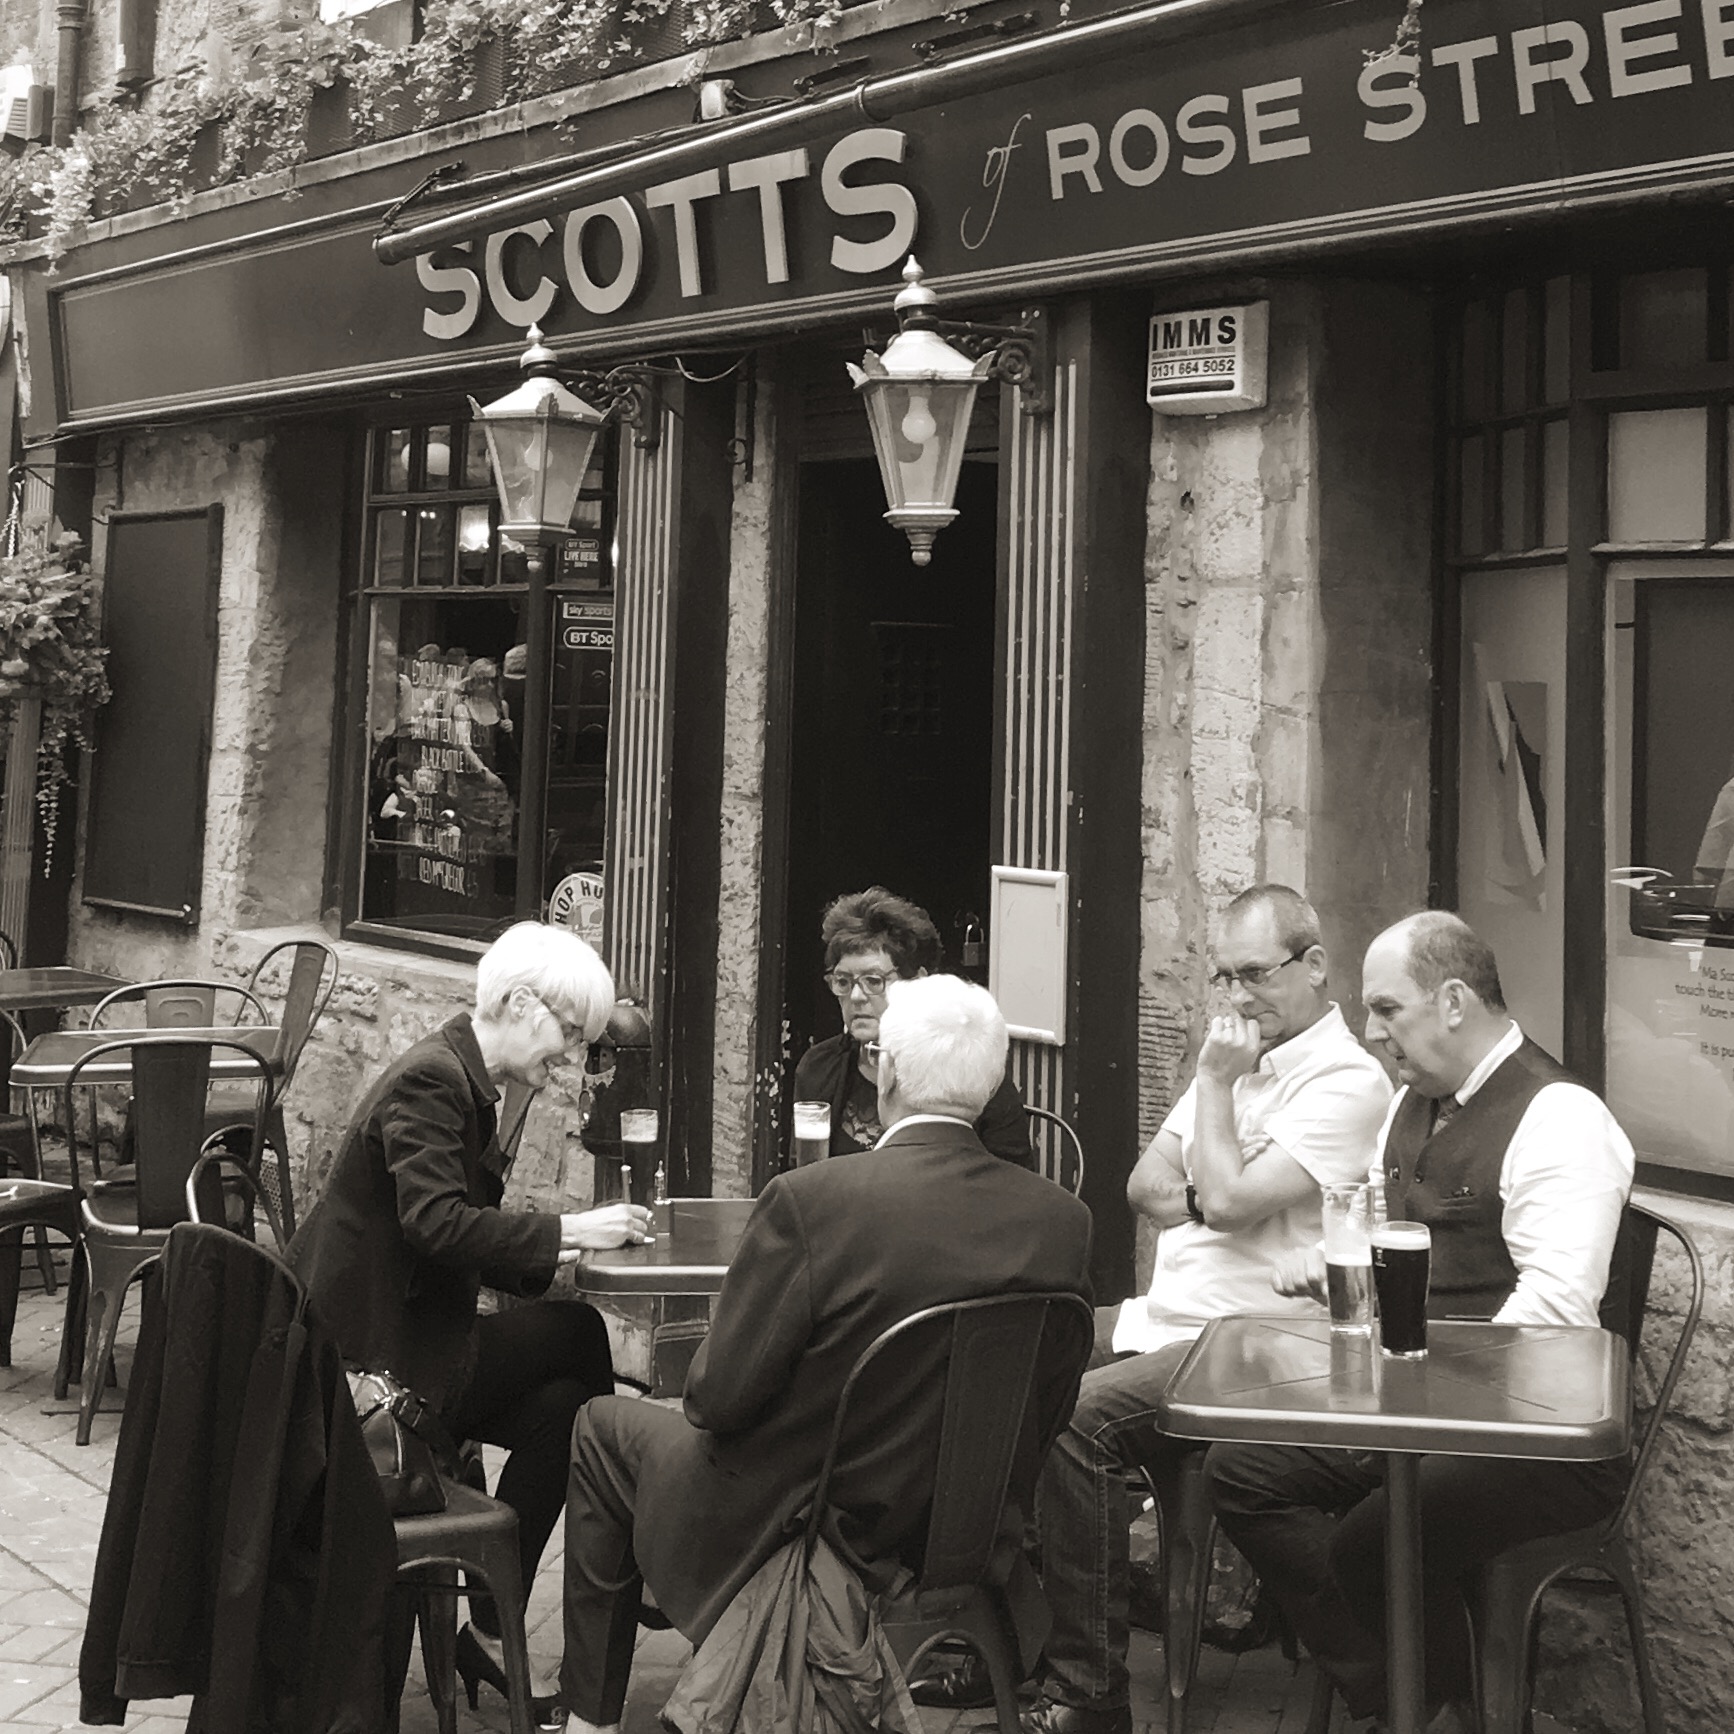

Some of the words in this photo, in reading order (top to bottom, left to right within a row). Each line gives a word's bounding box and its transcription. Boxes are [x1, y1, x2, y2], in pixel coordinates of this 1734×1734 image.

[416, 128, 919, 340] SCOTTS
[961, 112, 1032, 250] of
[1045, 76, 1311, 200] ROSE
[1151, 315, 1237, 352] IMMS
[1151, 363, 1175, 378] 0131
[1178, 361, 1199, 375] 664
[1202, 359, 1235, 373] 5052
[570, 632, 589, 644] BT
[554, 886, 575, 925] HOP
[580, 879, 603, 900] HU
